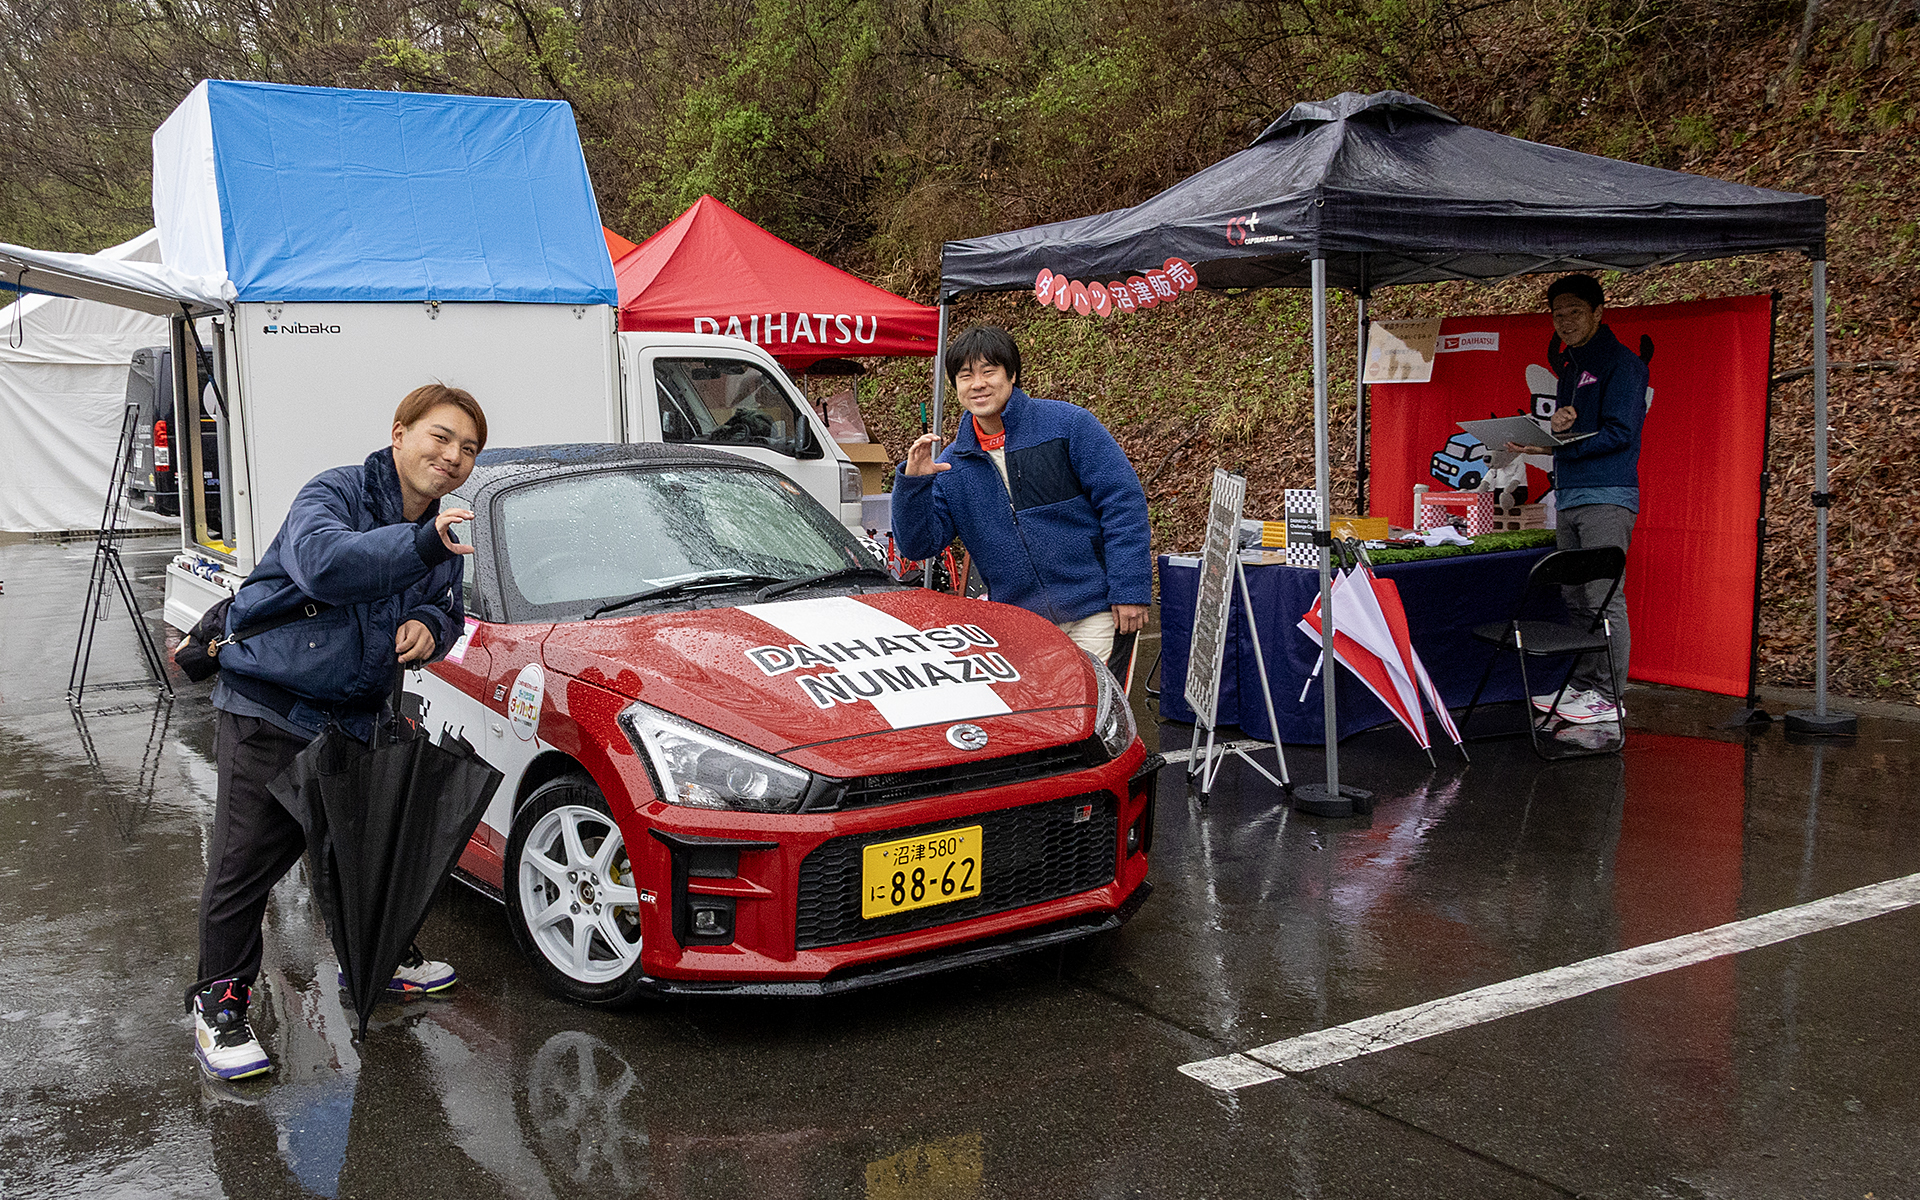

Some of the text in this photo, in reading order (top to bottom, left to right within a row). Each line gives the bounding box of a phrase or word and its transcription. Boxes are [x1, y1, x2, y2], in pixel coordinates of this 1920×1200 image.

[1038, 261, 1194, 310] ダイハツ沼津販売
[693, 312, 877, 345] DAIHATSU
[1461, 337, 1494, 346] DAIHATSU
[748, 625, 996, 675] DAIHATSU
[800, 653, 1018, 706] NUMAZU
[640, 893, 656, 903] GR
[871, 857, 975, 906] に 88-62
